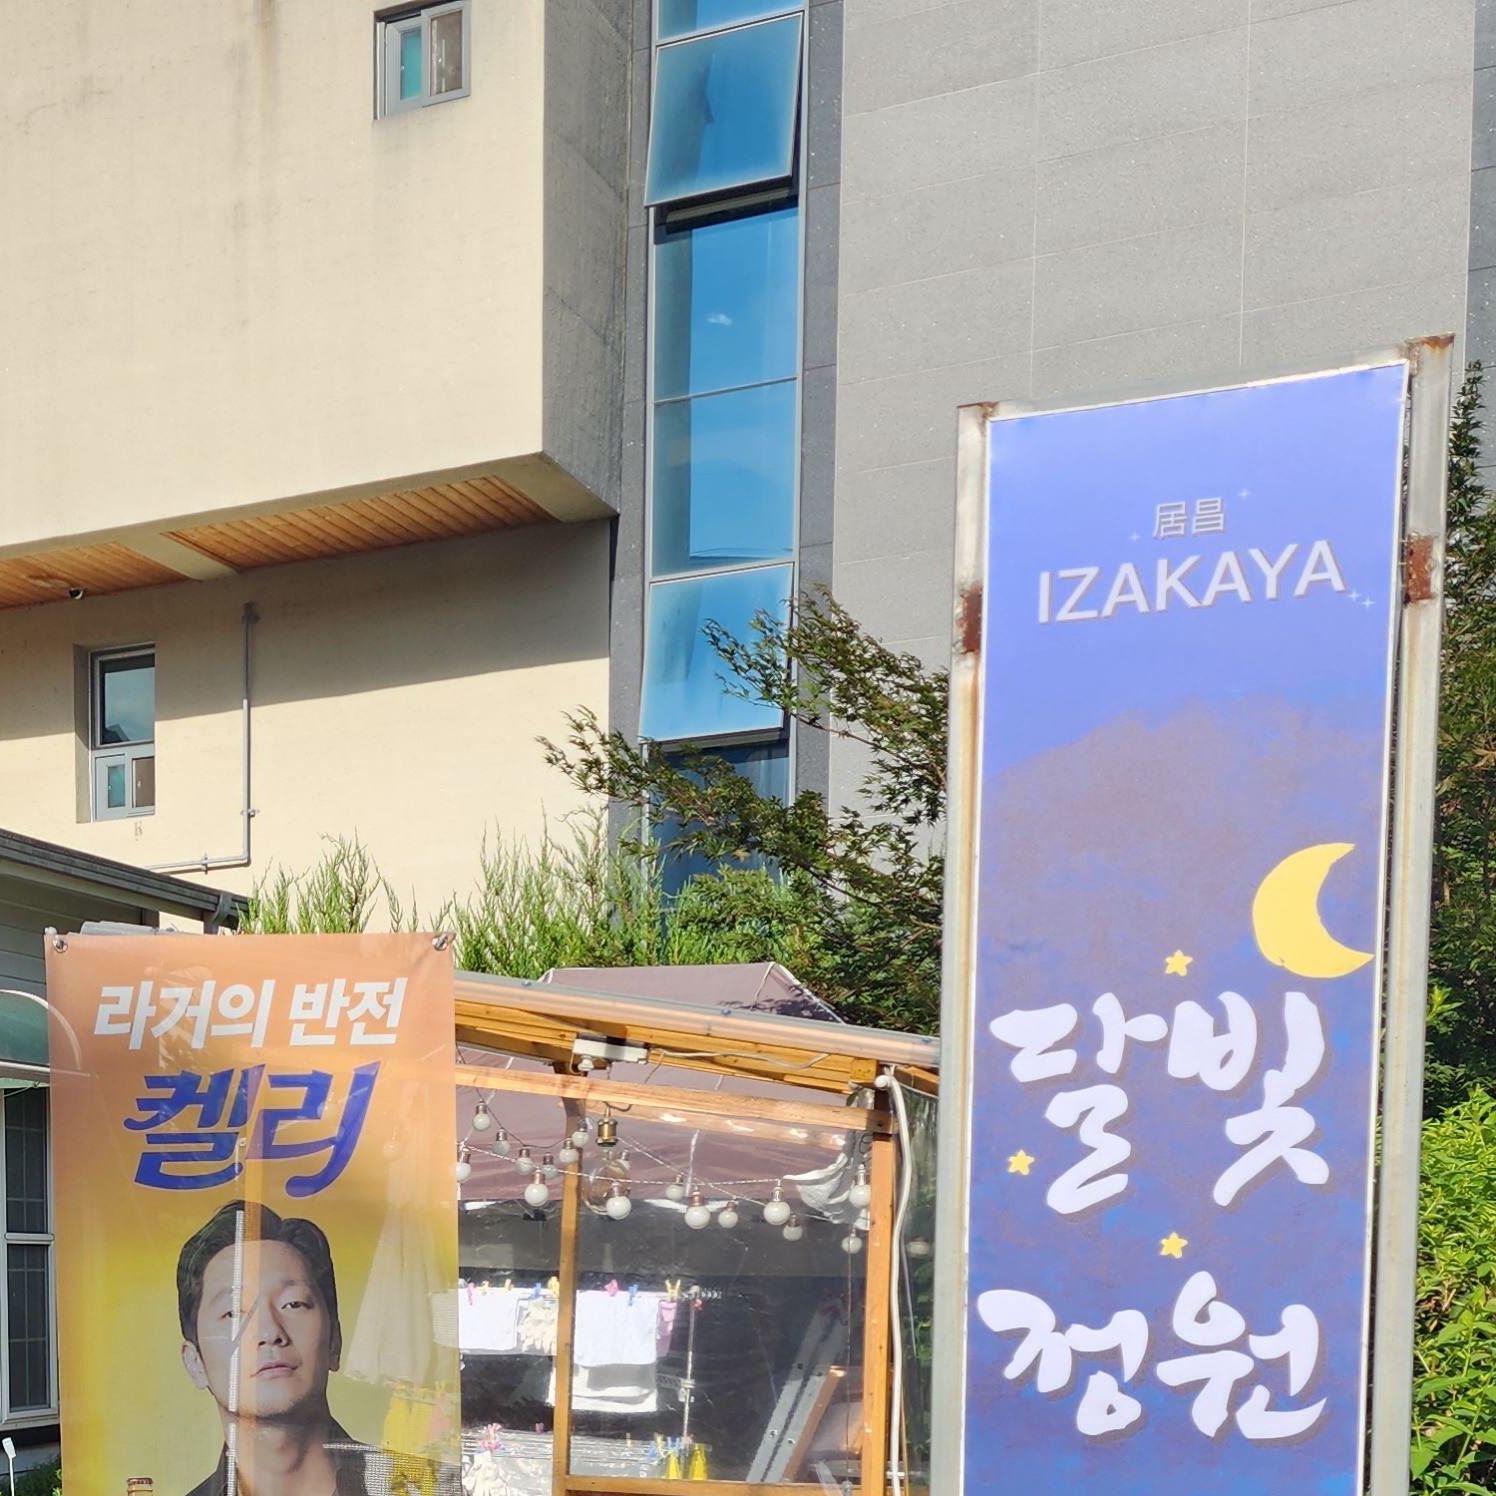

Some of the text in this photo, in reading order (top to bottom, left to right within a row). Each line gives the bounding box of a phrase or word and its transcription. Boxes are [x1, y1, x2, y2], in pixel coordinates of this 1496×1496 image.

[1152, 497, 1226, 539] 居昌
[1039, 539, 1346, 624] IZAKAYA
[94, 976, 409, 1050] 라거의 반전
[123, 1060, 382, 1198] 켈리
[990, 991, 1330, 1215] 달빛
[977, 1271, 1328, 1440] 정원
